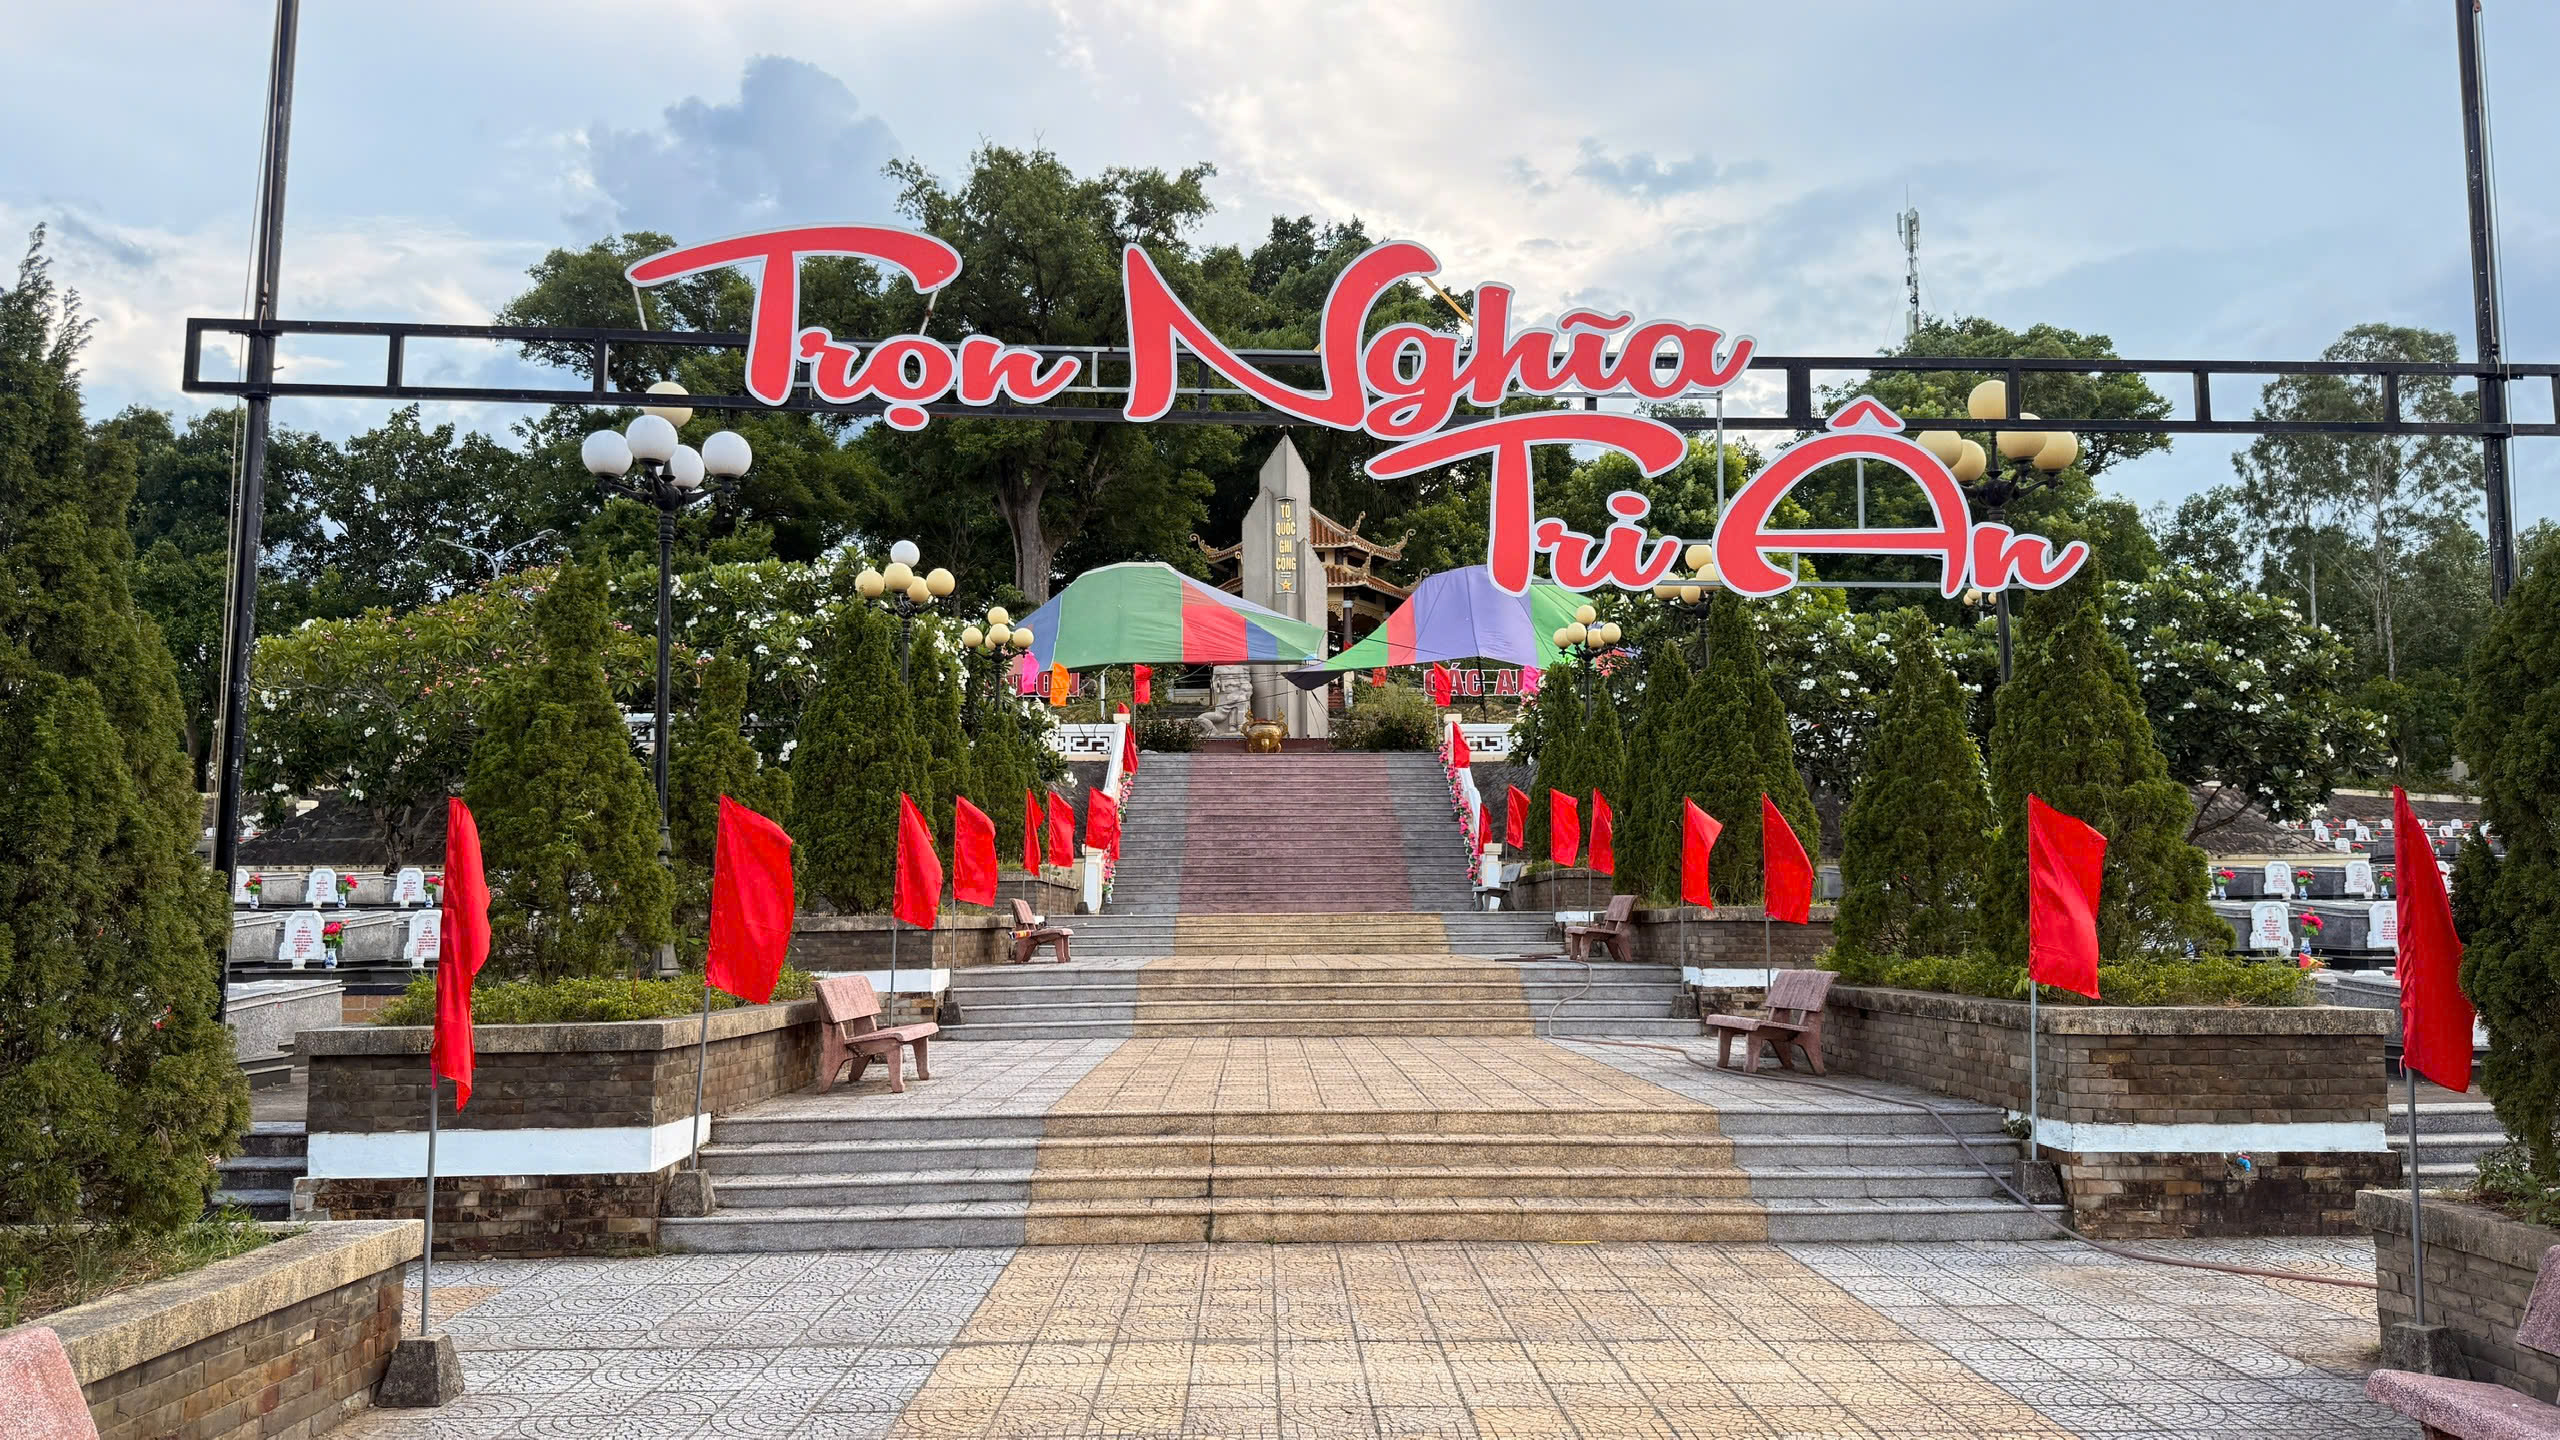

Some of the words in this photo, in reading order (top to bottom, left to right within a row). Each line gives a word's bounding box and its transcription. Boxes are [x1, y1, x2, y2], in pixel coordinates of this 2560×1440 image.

[626, 223, 1081, 431] Trọn
[1123, 239, 1756, 440] Nghĩa
[1365, 411, 1688, 597] Tri
[1712, 395, 2089, 599] Ân
[1275, 518, 1296, 536] QUỐC
[1279, 539, 1292, 553] GHI
[1275, 554, 1297, 570] CÔNG
